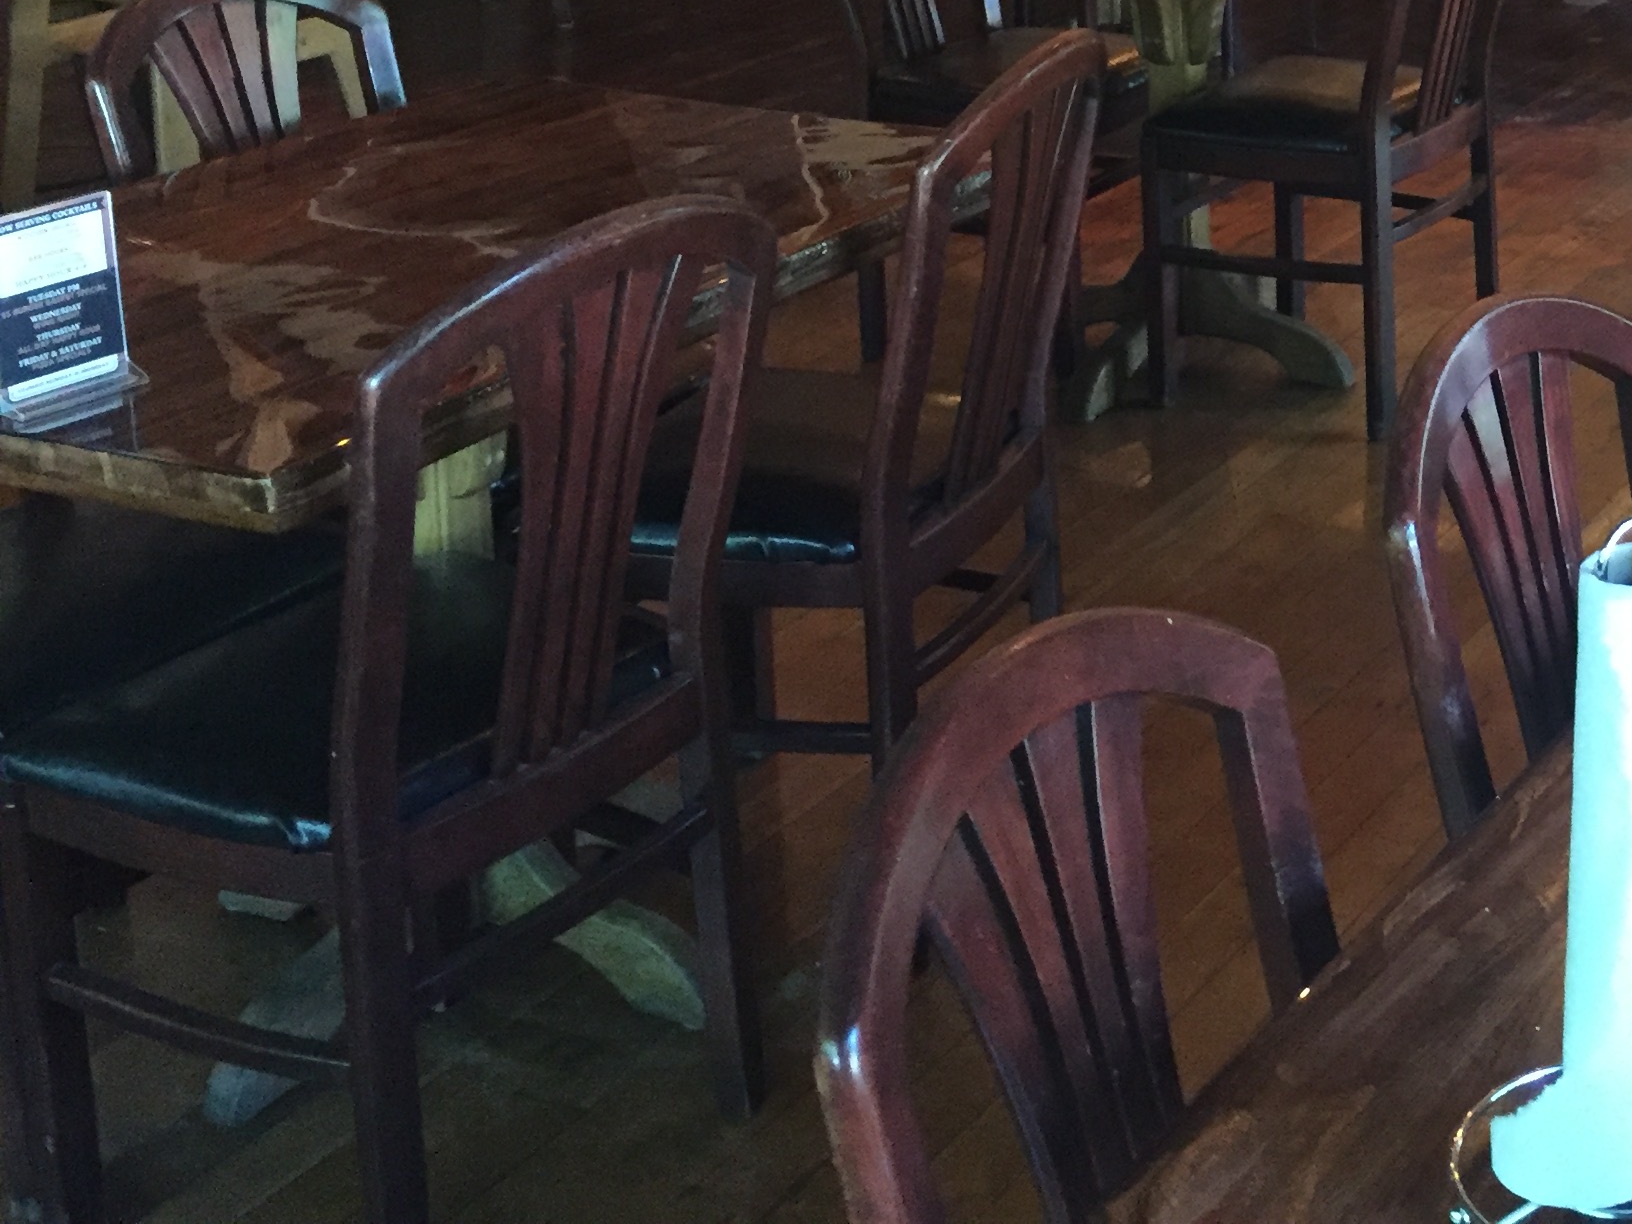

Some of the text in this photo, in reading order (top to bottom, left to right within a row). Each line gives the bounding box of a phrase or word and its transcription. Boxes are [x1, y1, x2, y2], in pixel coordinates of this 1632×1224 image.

[0, 223, 13, 234] OW
[15, 213, 52, 230] SERVING
[51, 201, 98, 220] COCKTAILS
[27, 286, 66, 304] TUESDAY
[29, 301, 82, 323] WEDNESDAY
[36, 322, 82, 342] THURSDAY
[18, 351, 50, 368] FRIDAY
[58, 336, 103, 355] SATURDAY
